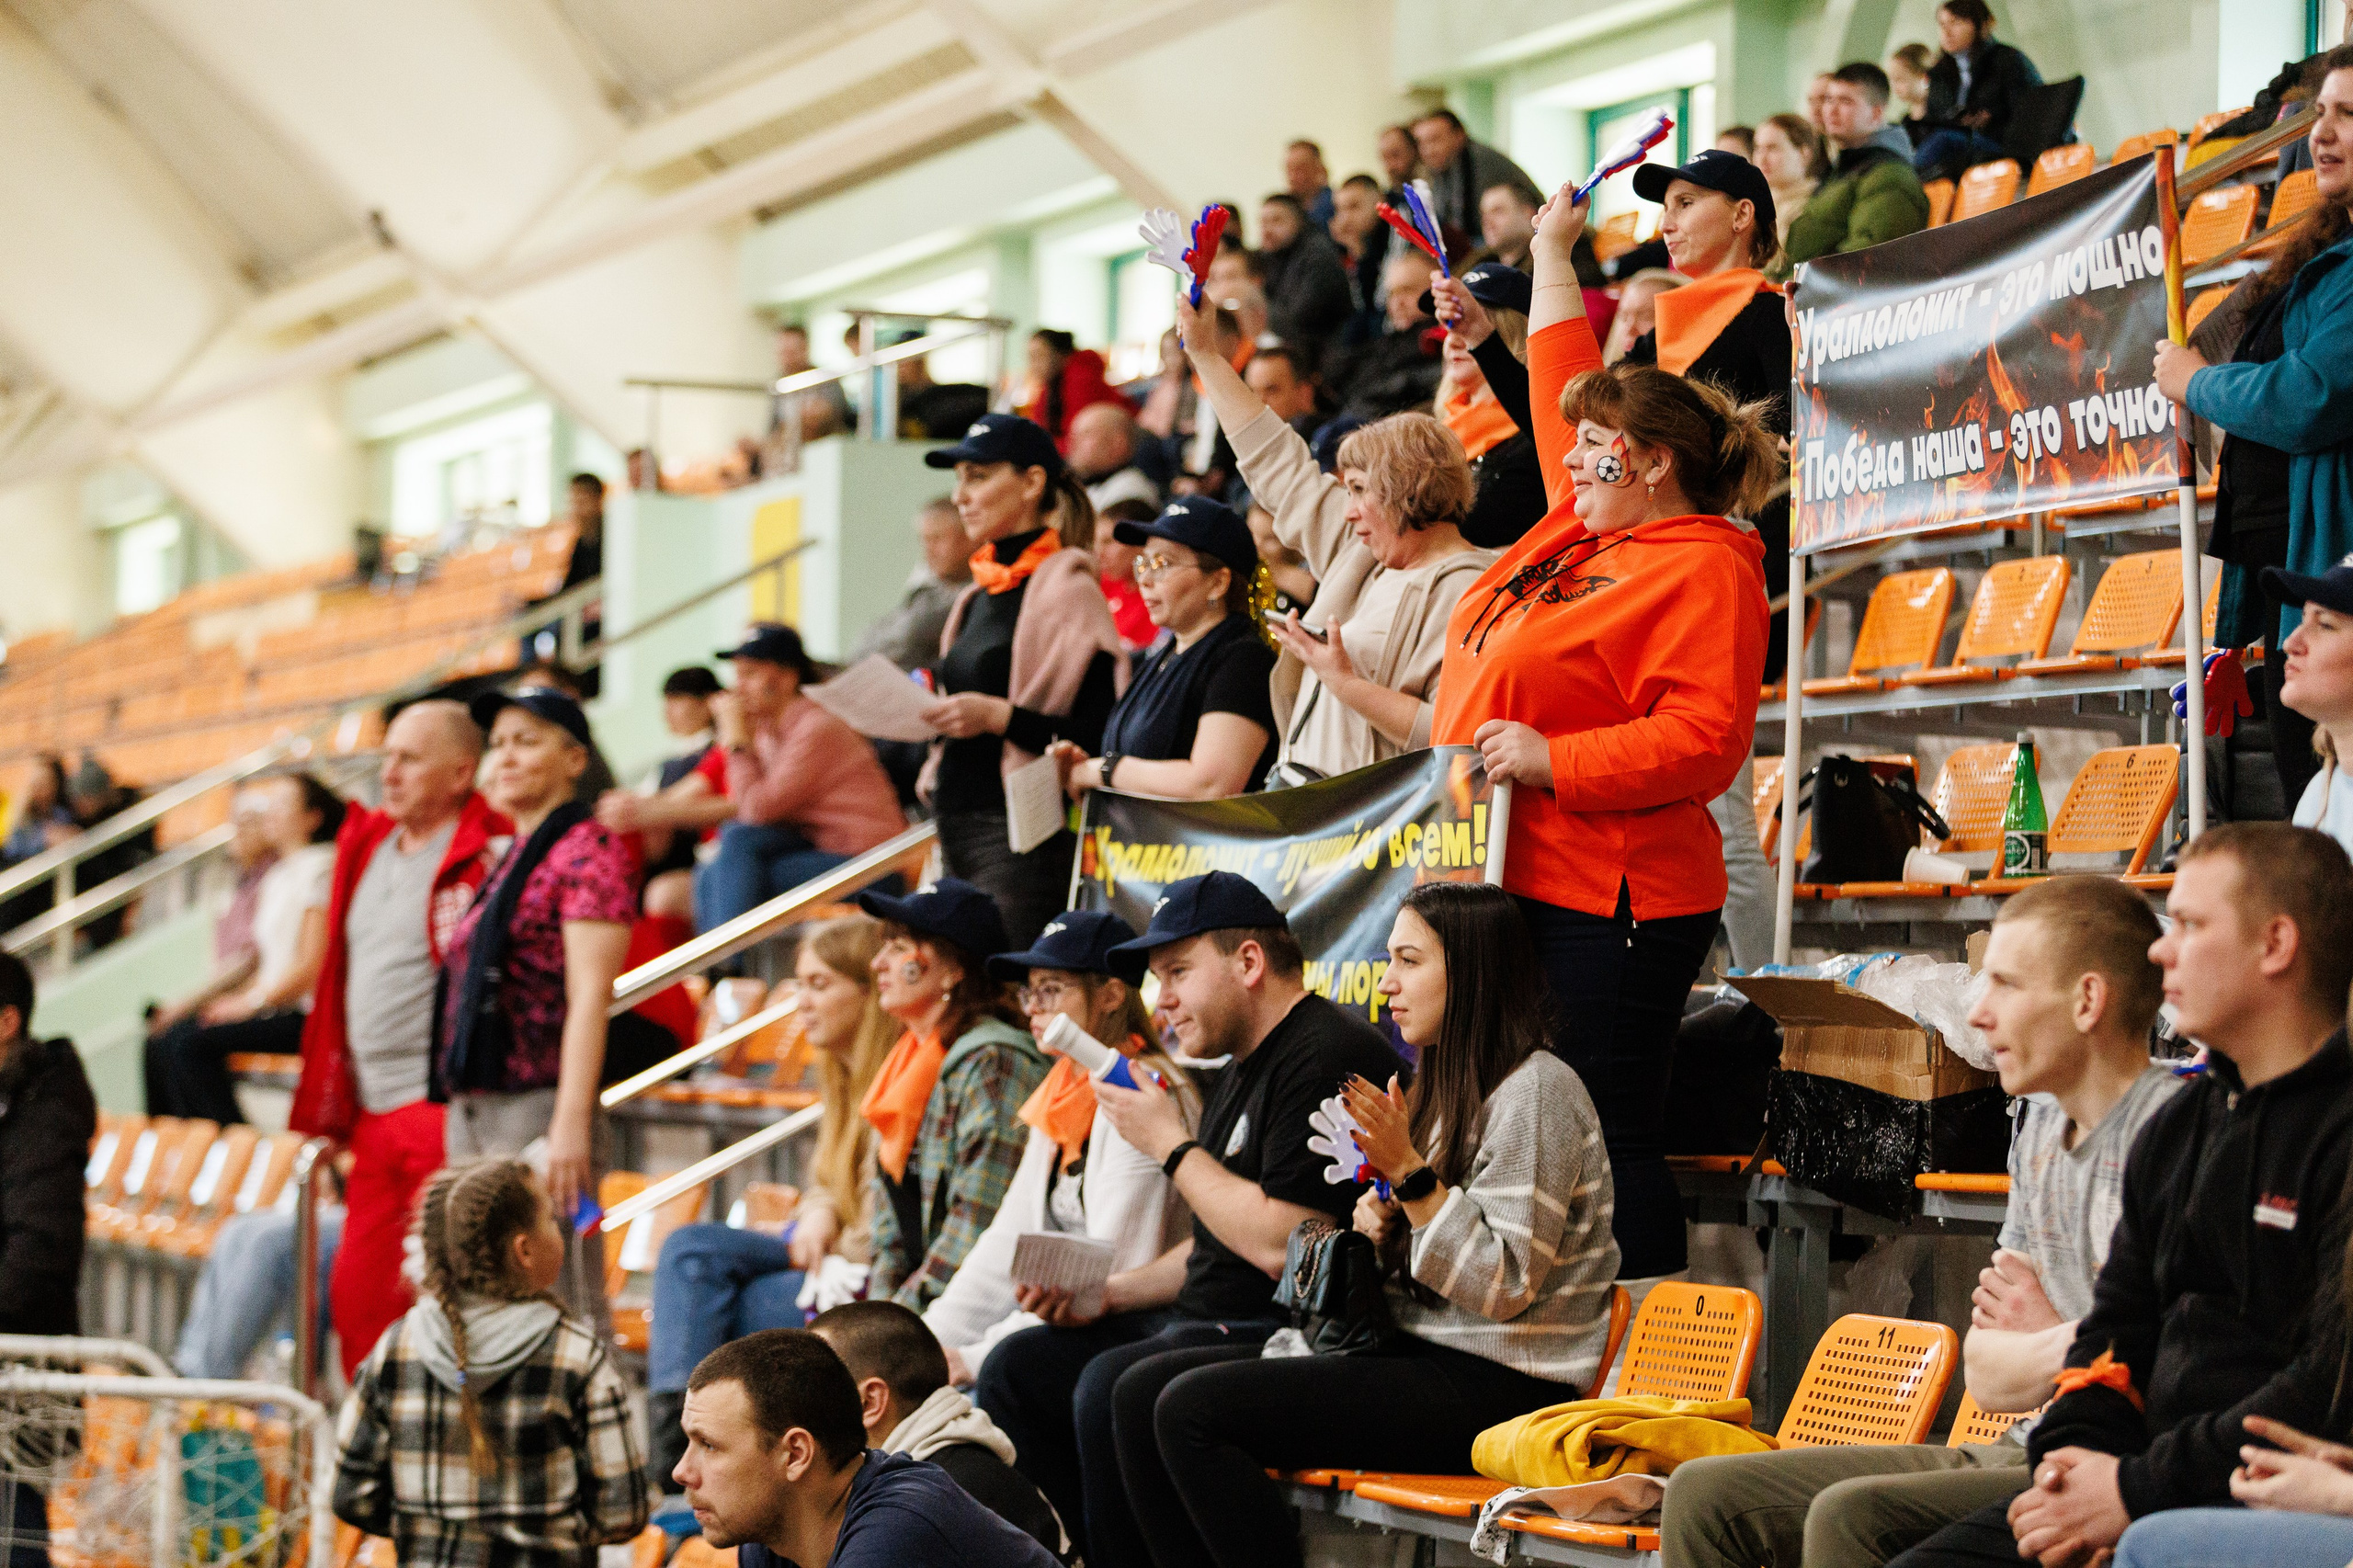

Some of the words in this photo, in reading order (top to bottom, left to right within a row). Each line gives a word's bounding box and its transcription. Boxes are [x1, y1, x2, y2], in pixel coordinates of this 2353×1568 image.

[1796, 283, 1975, 384] Уралдоломит
[1979, 287, 1994, 308] -
[1998, 260, 2045, 315] это
[2050, 225, 2165, 301] мощно
[1804, 432, 1905, 503] Победа
[1912, 423, 1985, 482] наша
[1989, 429, 2005, 450] -
[2010, 404, 2063, 460] это
[2126, 753, 2136, 769] 6
[1388, 803, 1487, 869] всем!
[1696, 1294, 1705, 1316] 0
[1878, 1326, 1896, 1349] 11
